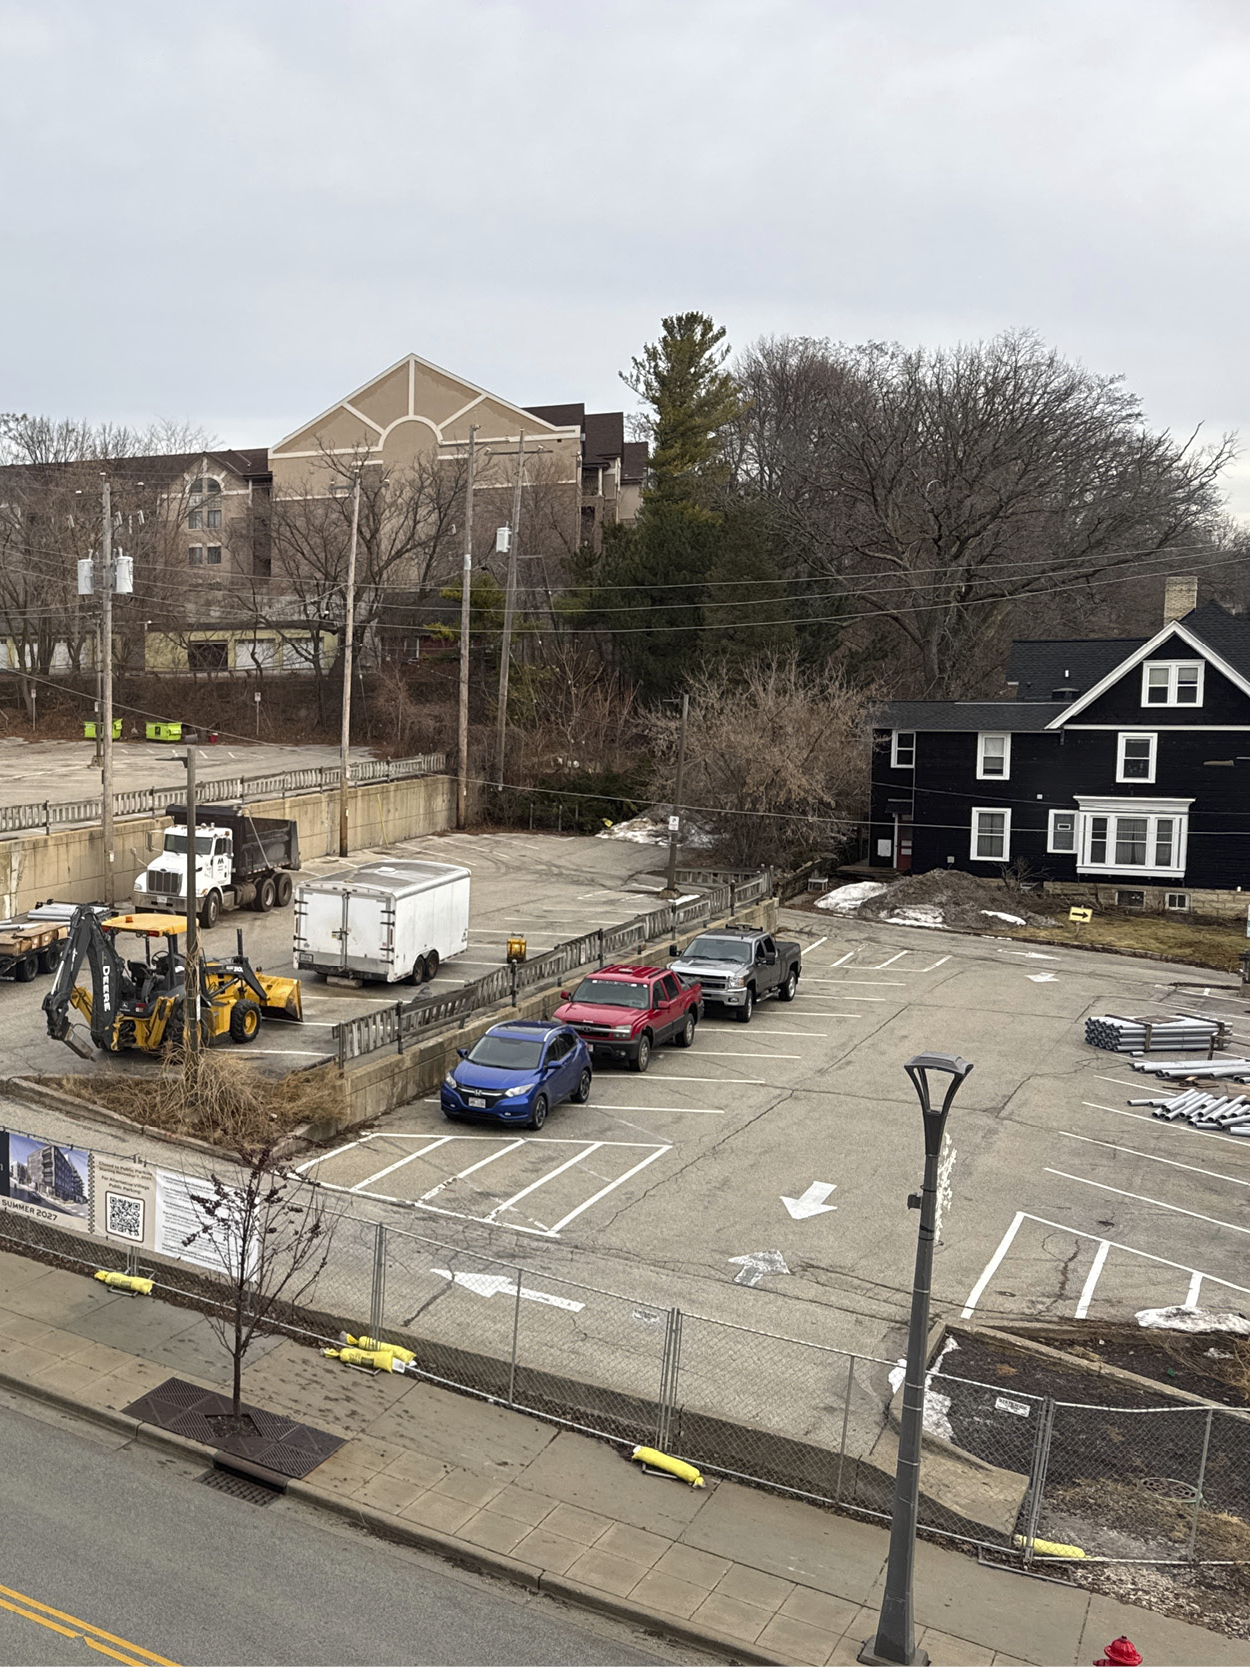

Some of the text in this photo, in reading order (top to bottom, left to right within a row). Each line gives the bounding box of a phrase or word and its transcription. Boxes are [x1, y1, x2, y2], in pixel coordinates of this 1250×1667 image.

[102, 966, 111, 1012] DEERE
[2, 1199, 35, 1215] SUMMER
[36, 1209, 58, 1221] 2027
